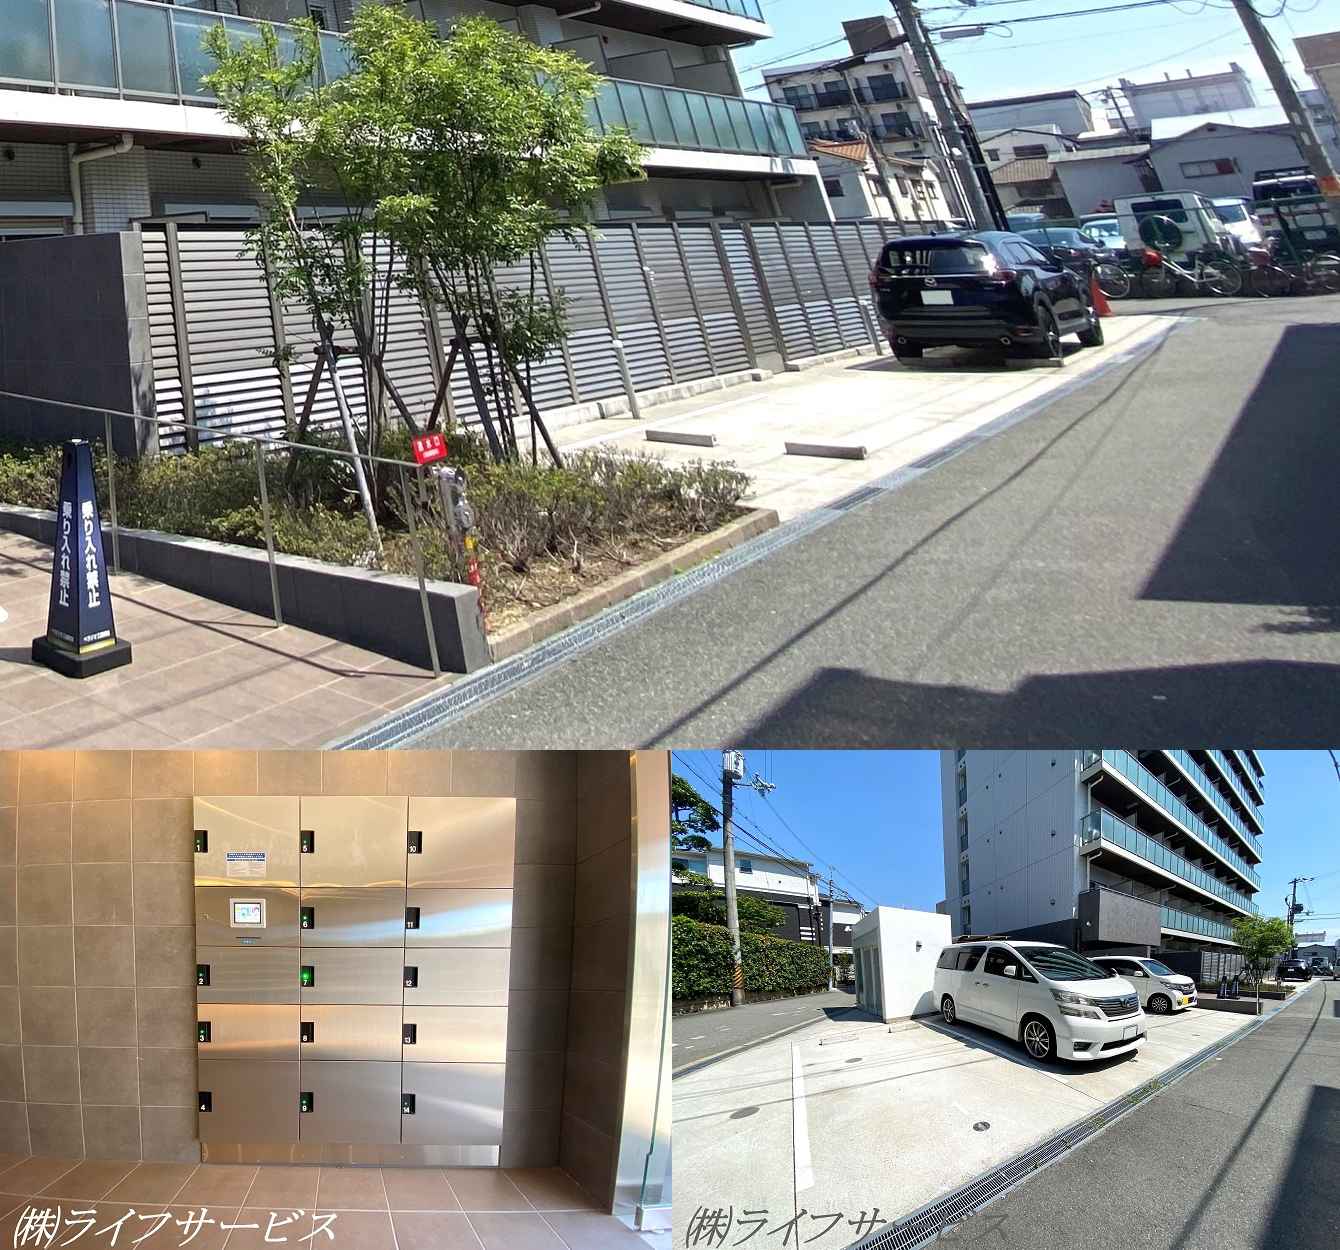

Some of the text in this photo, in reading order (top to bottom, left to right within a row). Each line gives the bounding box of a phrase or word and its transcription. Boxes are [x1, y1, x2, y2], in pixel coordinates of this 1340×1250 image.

[58, 501, 73, 608] 乗り入れ禁止
[81, 500, 101, 609] 乗り入れ禁止
